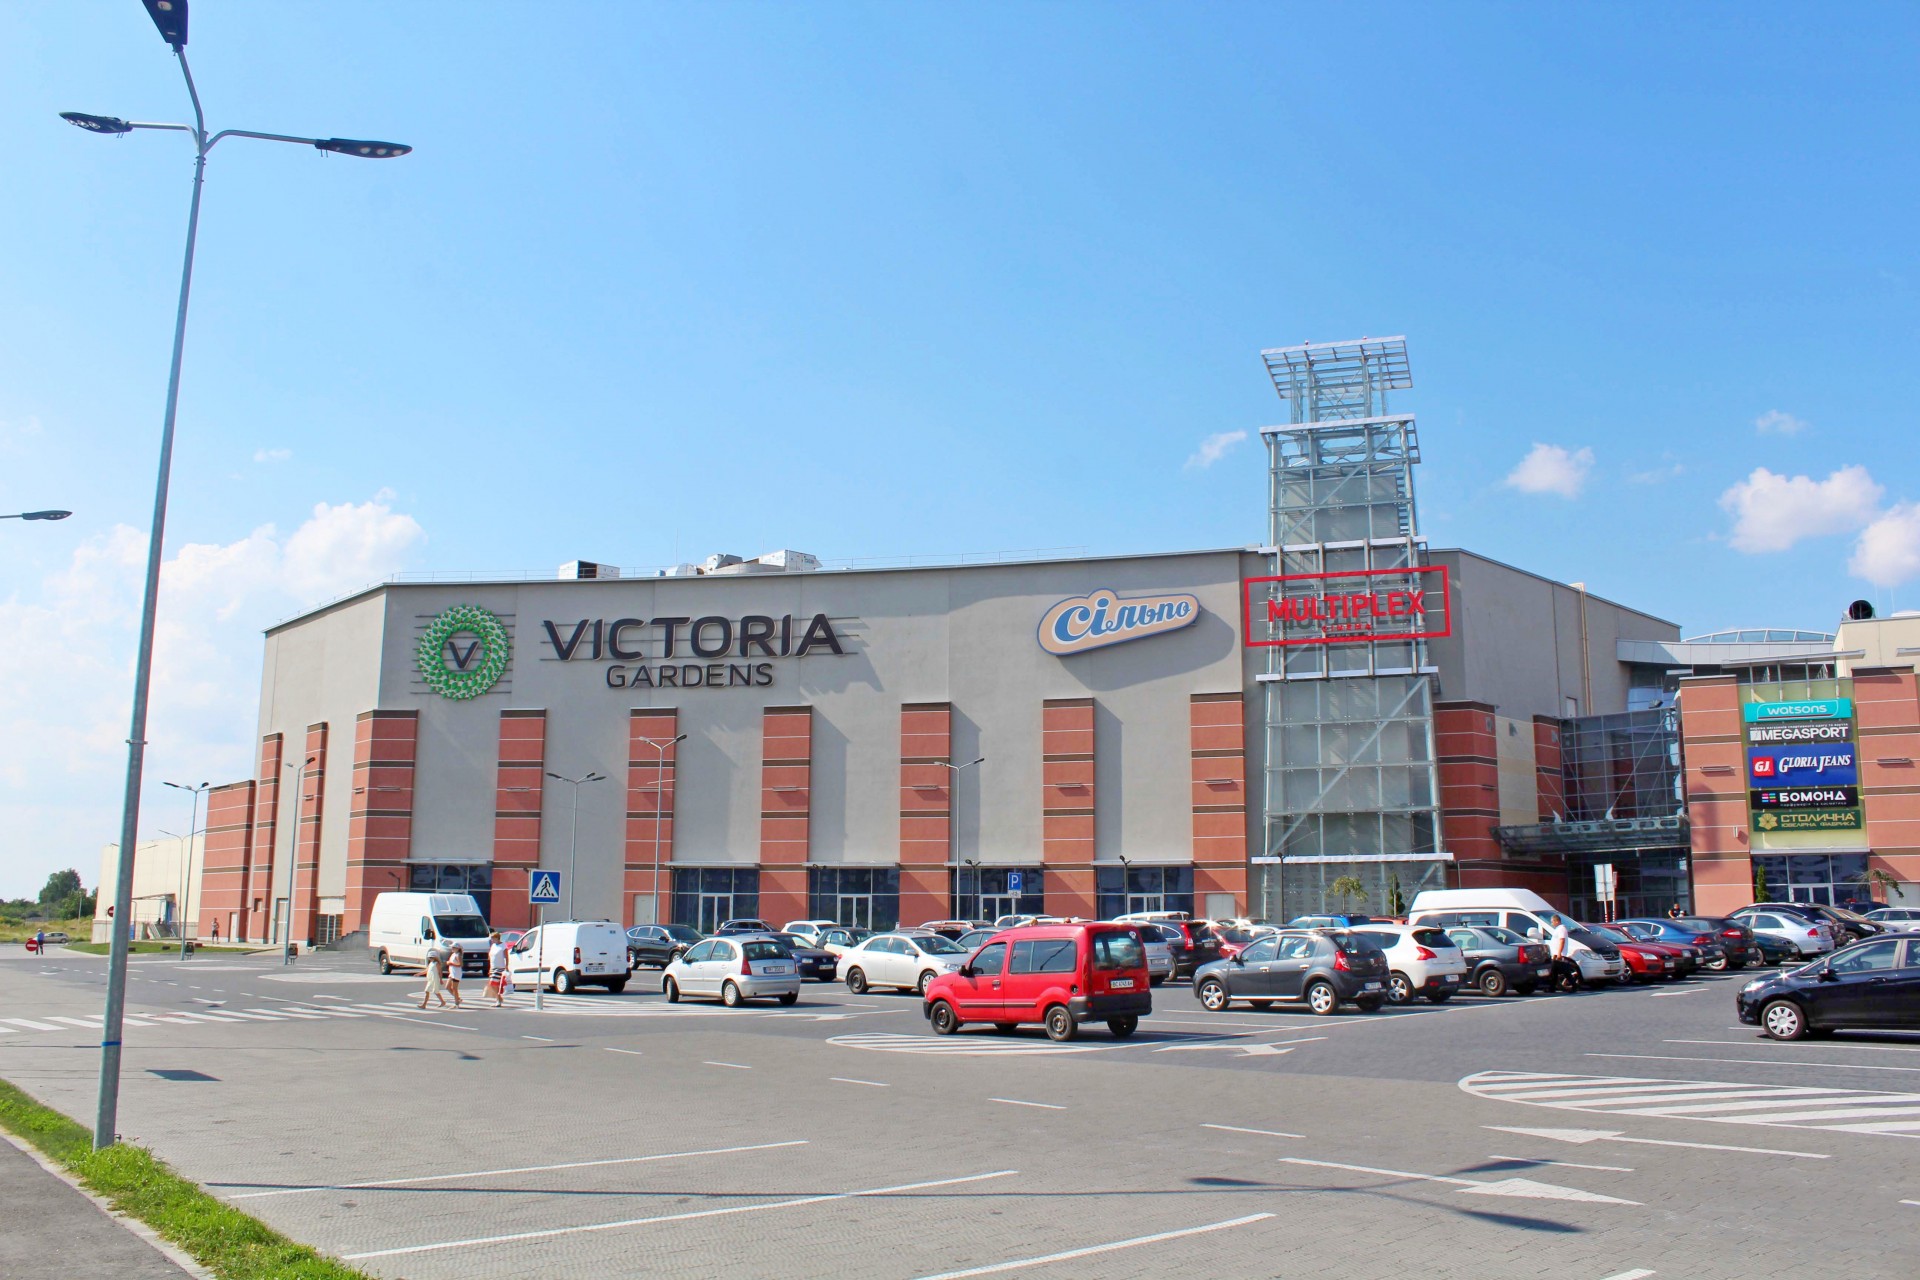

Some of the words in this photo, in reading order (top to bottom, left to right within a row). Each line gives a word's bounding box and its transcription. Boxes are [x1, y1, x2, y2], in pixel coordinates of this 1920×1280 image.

[1267, 590, 1425, 622] MULTIPLEX
[1054, 598, 1192, 642] Сільпо
[1321, 623, 1372, 632] CINEMA
[543, 613, 844, 661] VICTORIA
[448, 640, 479, 670] V
[606, 662, 774, 689] GARDENS
[1767, 704, 1827, 715] watsons
[1762, 727, 1849, 741] MEGASPORT
[1779, 756, 1818, 773] GLORIA
[1816, 755, 1852, 773] JEANS
[1779, 791, 1847, 803] БОМОНД
[1780, 813, 1855, 823] СТОЛИЧНА
[1011, 875, 1019, 888] P
